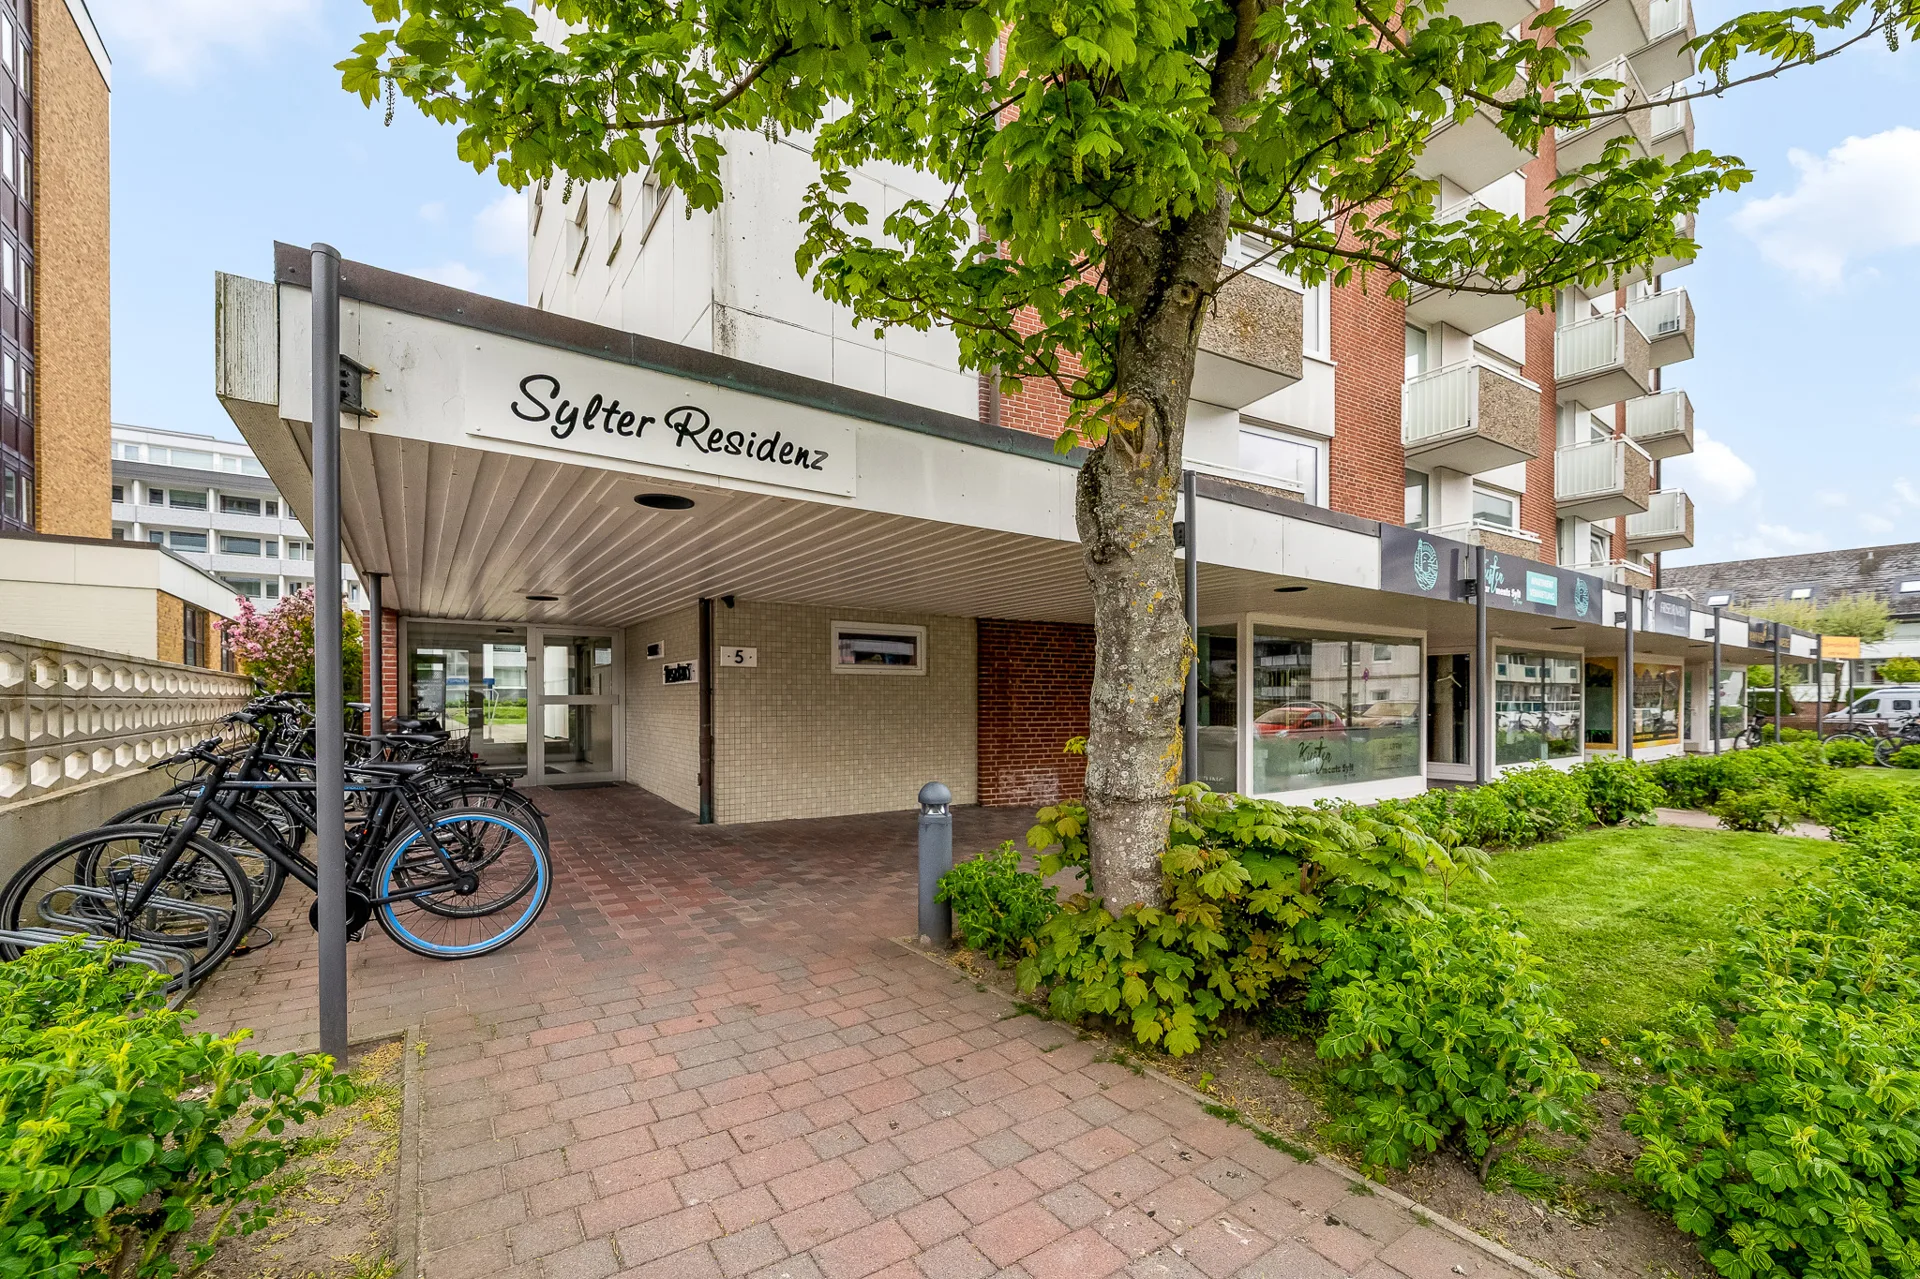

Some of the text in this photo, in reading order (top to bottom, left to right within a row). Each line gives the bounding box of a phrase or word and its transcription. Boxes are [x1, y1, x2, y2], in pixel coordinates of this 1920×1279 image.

[511, 374, 829, 471] Sylter Residenz
[734, 649, 745, 664] 5
